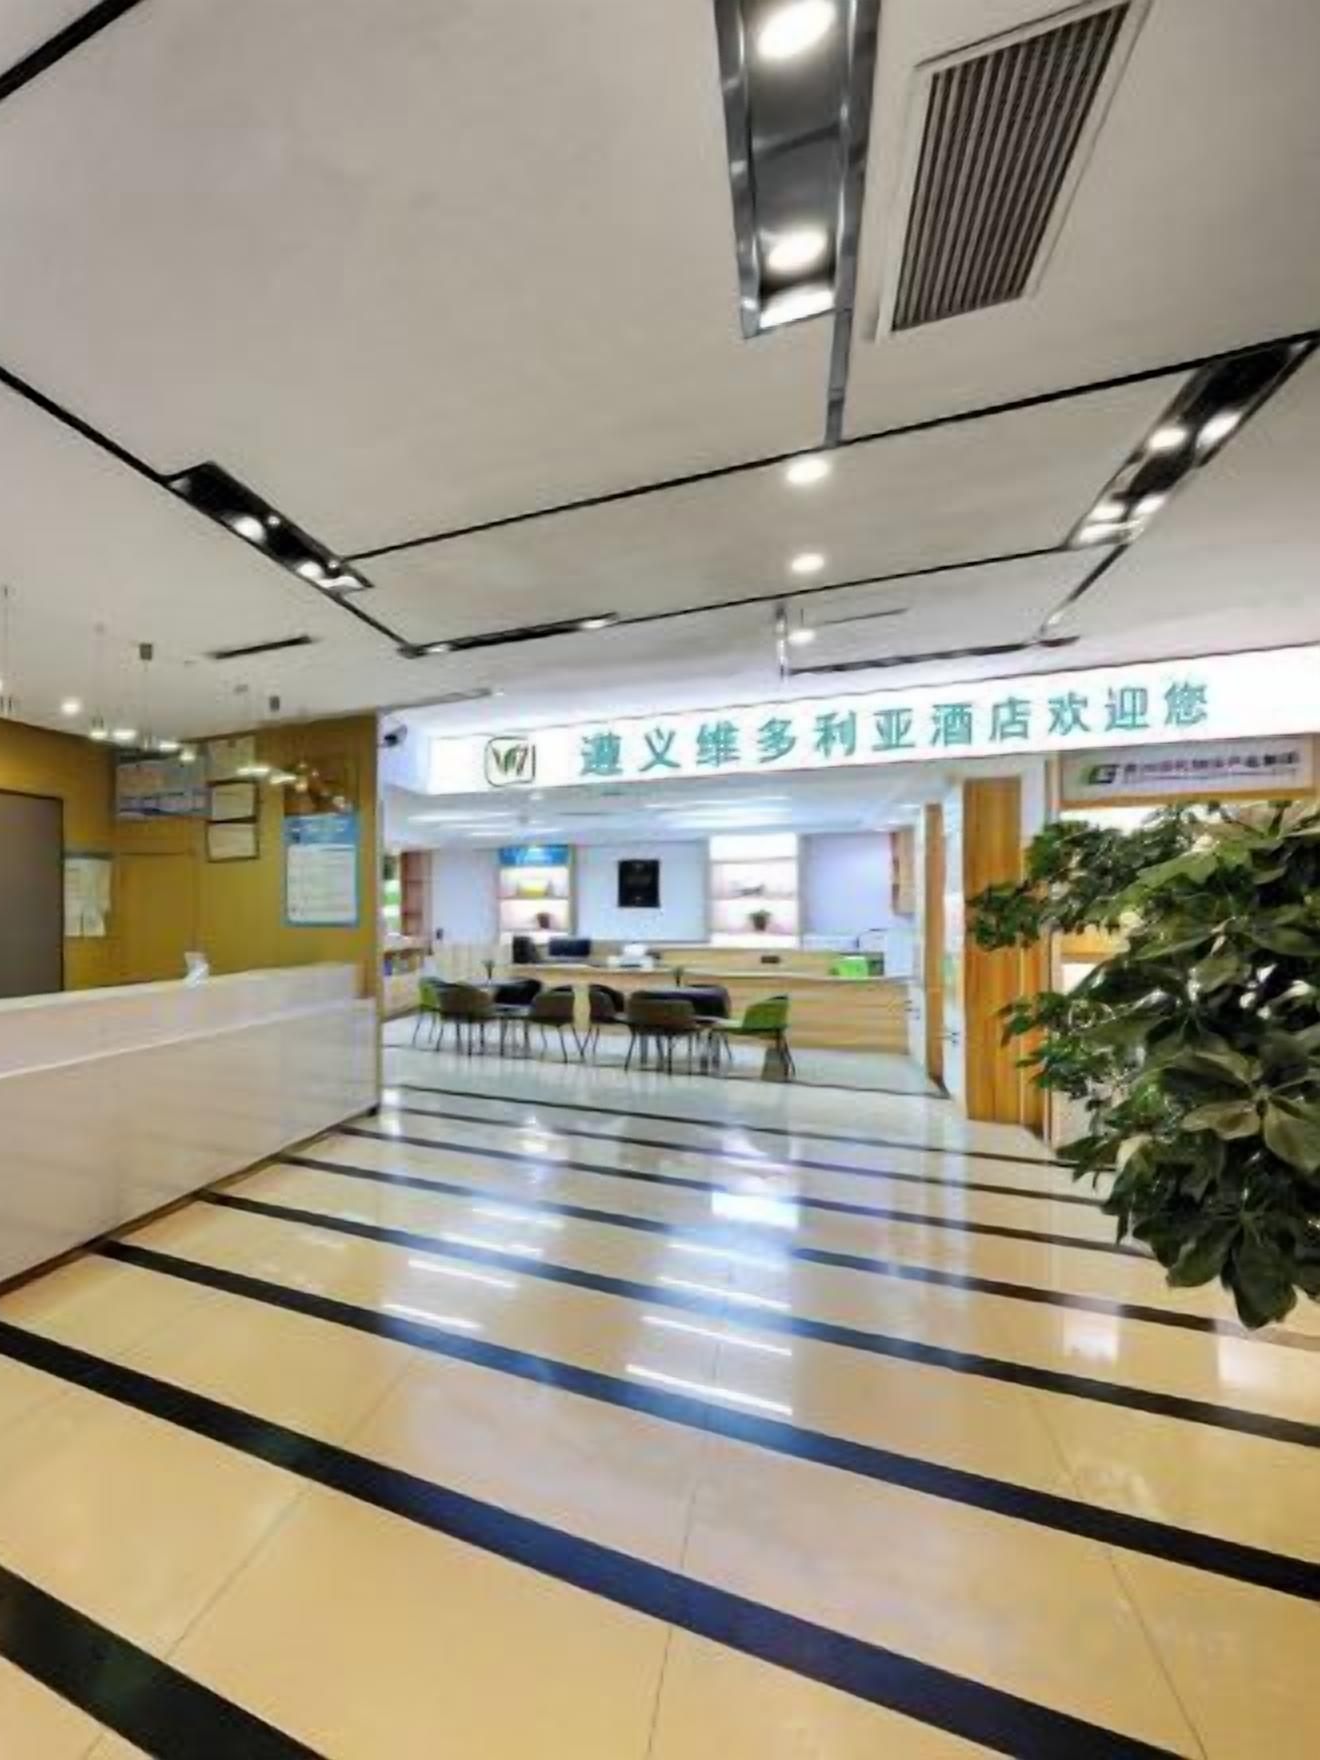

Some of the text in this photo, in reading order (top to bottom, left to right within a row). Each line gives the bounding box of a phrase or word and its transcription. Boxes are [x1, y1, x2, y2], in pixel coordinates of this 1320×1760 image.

[580, 680, 1208, 776] 遵义维多利亚酒店欢迎您
